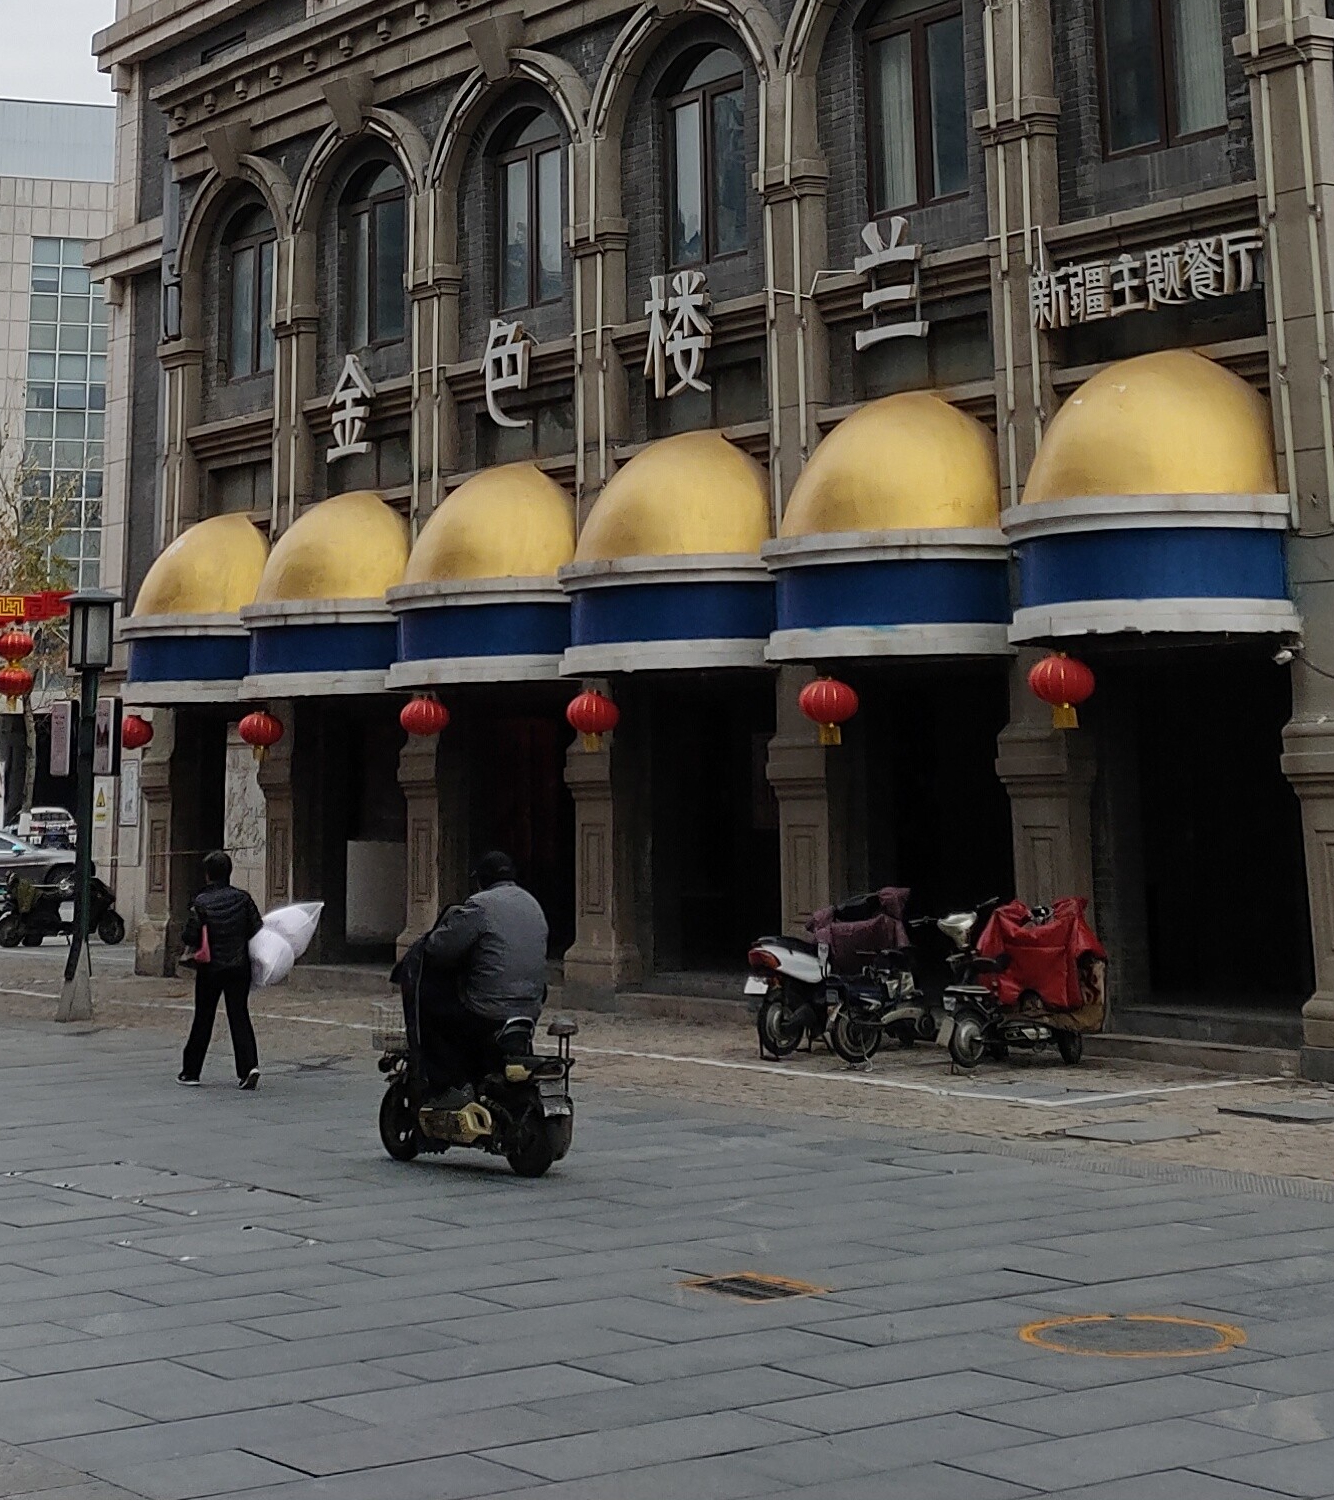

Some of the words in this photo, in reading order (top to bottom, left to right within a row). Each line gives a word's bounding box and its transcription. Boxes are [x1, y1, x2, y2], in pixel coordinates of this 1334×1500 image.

[326, 216, 929, 464] 金色楼兰
[1028, 228, 1266, 331] 新疆主题餐厅
